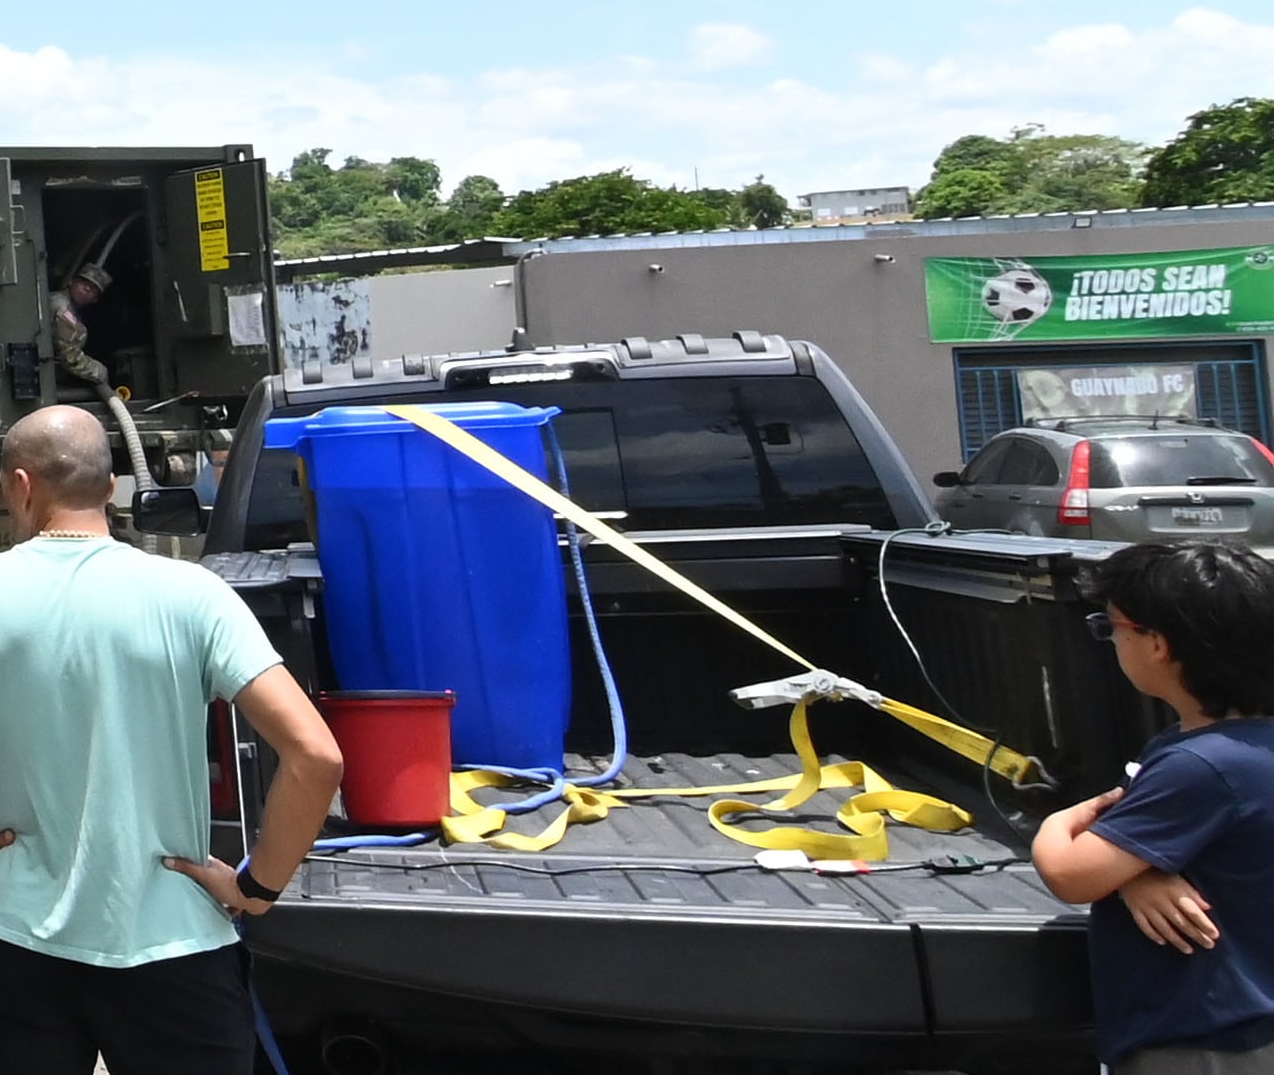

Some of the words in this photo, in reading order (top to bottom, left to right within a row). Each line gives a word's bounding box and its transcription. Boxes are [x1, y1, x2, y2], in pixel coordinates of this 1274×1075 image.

[1071, 268, 1156, 296] ¡TODOS
[1162, 264, 1225, 290] SEAN
[1065, 290, 1231, 321] BIENVENIDOS!
